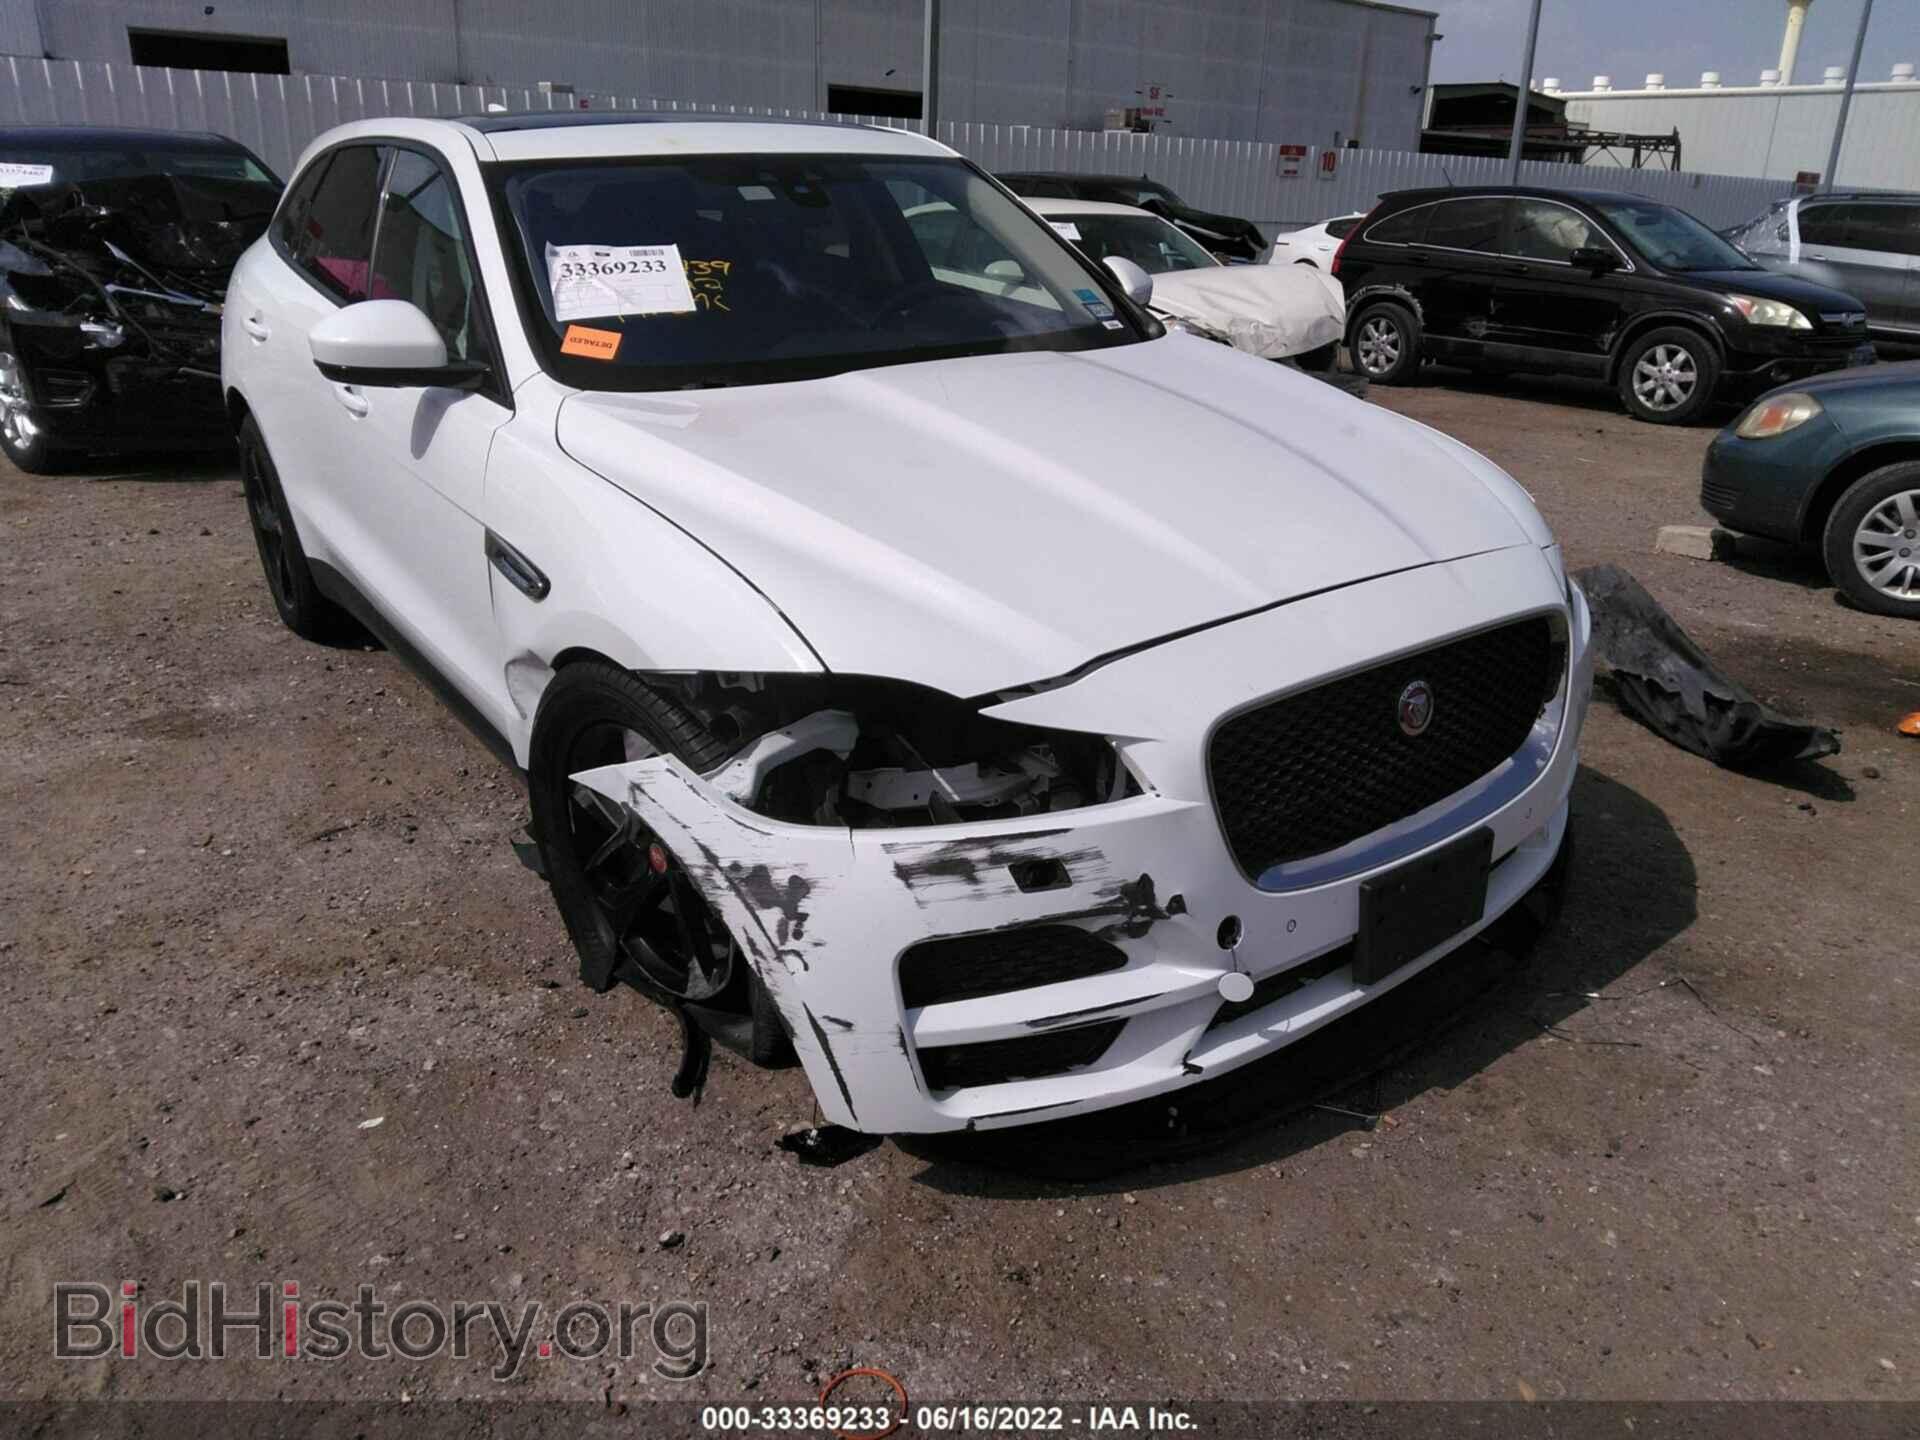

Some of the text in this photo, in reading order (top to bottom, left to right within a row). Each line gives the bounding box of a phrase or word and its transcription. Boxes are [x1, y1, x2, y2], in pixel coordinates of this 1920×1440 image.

[1322, 151, 1336, 172] 10
[561, 260, 667, 278] 33369233
[569, 336, 613, 349] DETAILED
